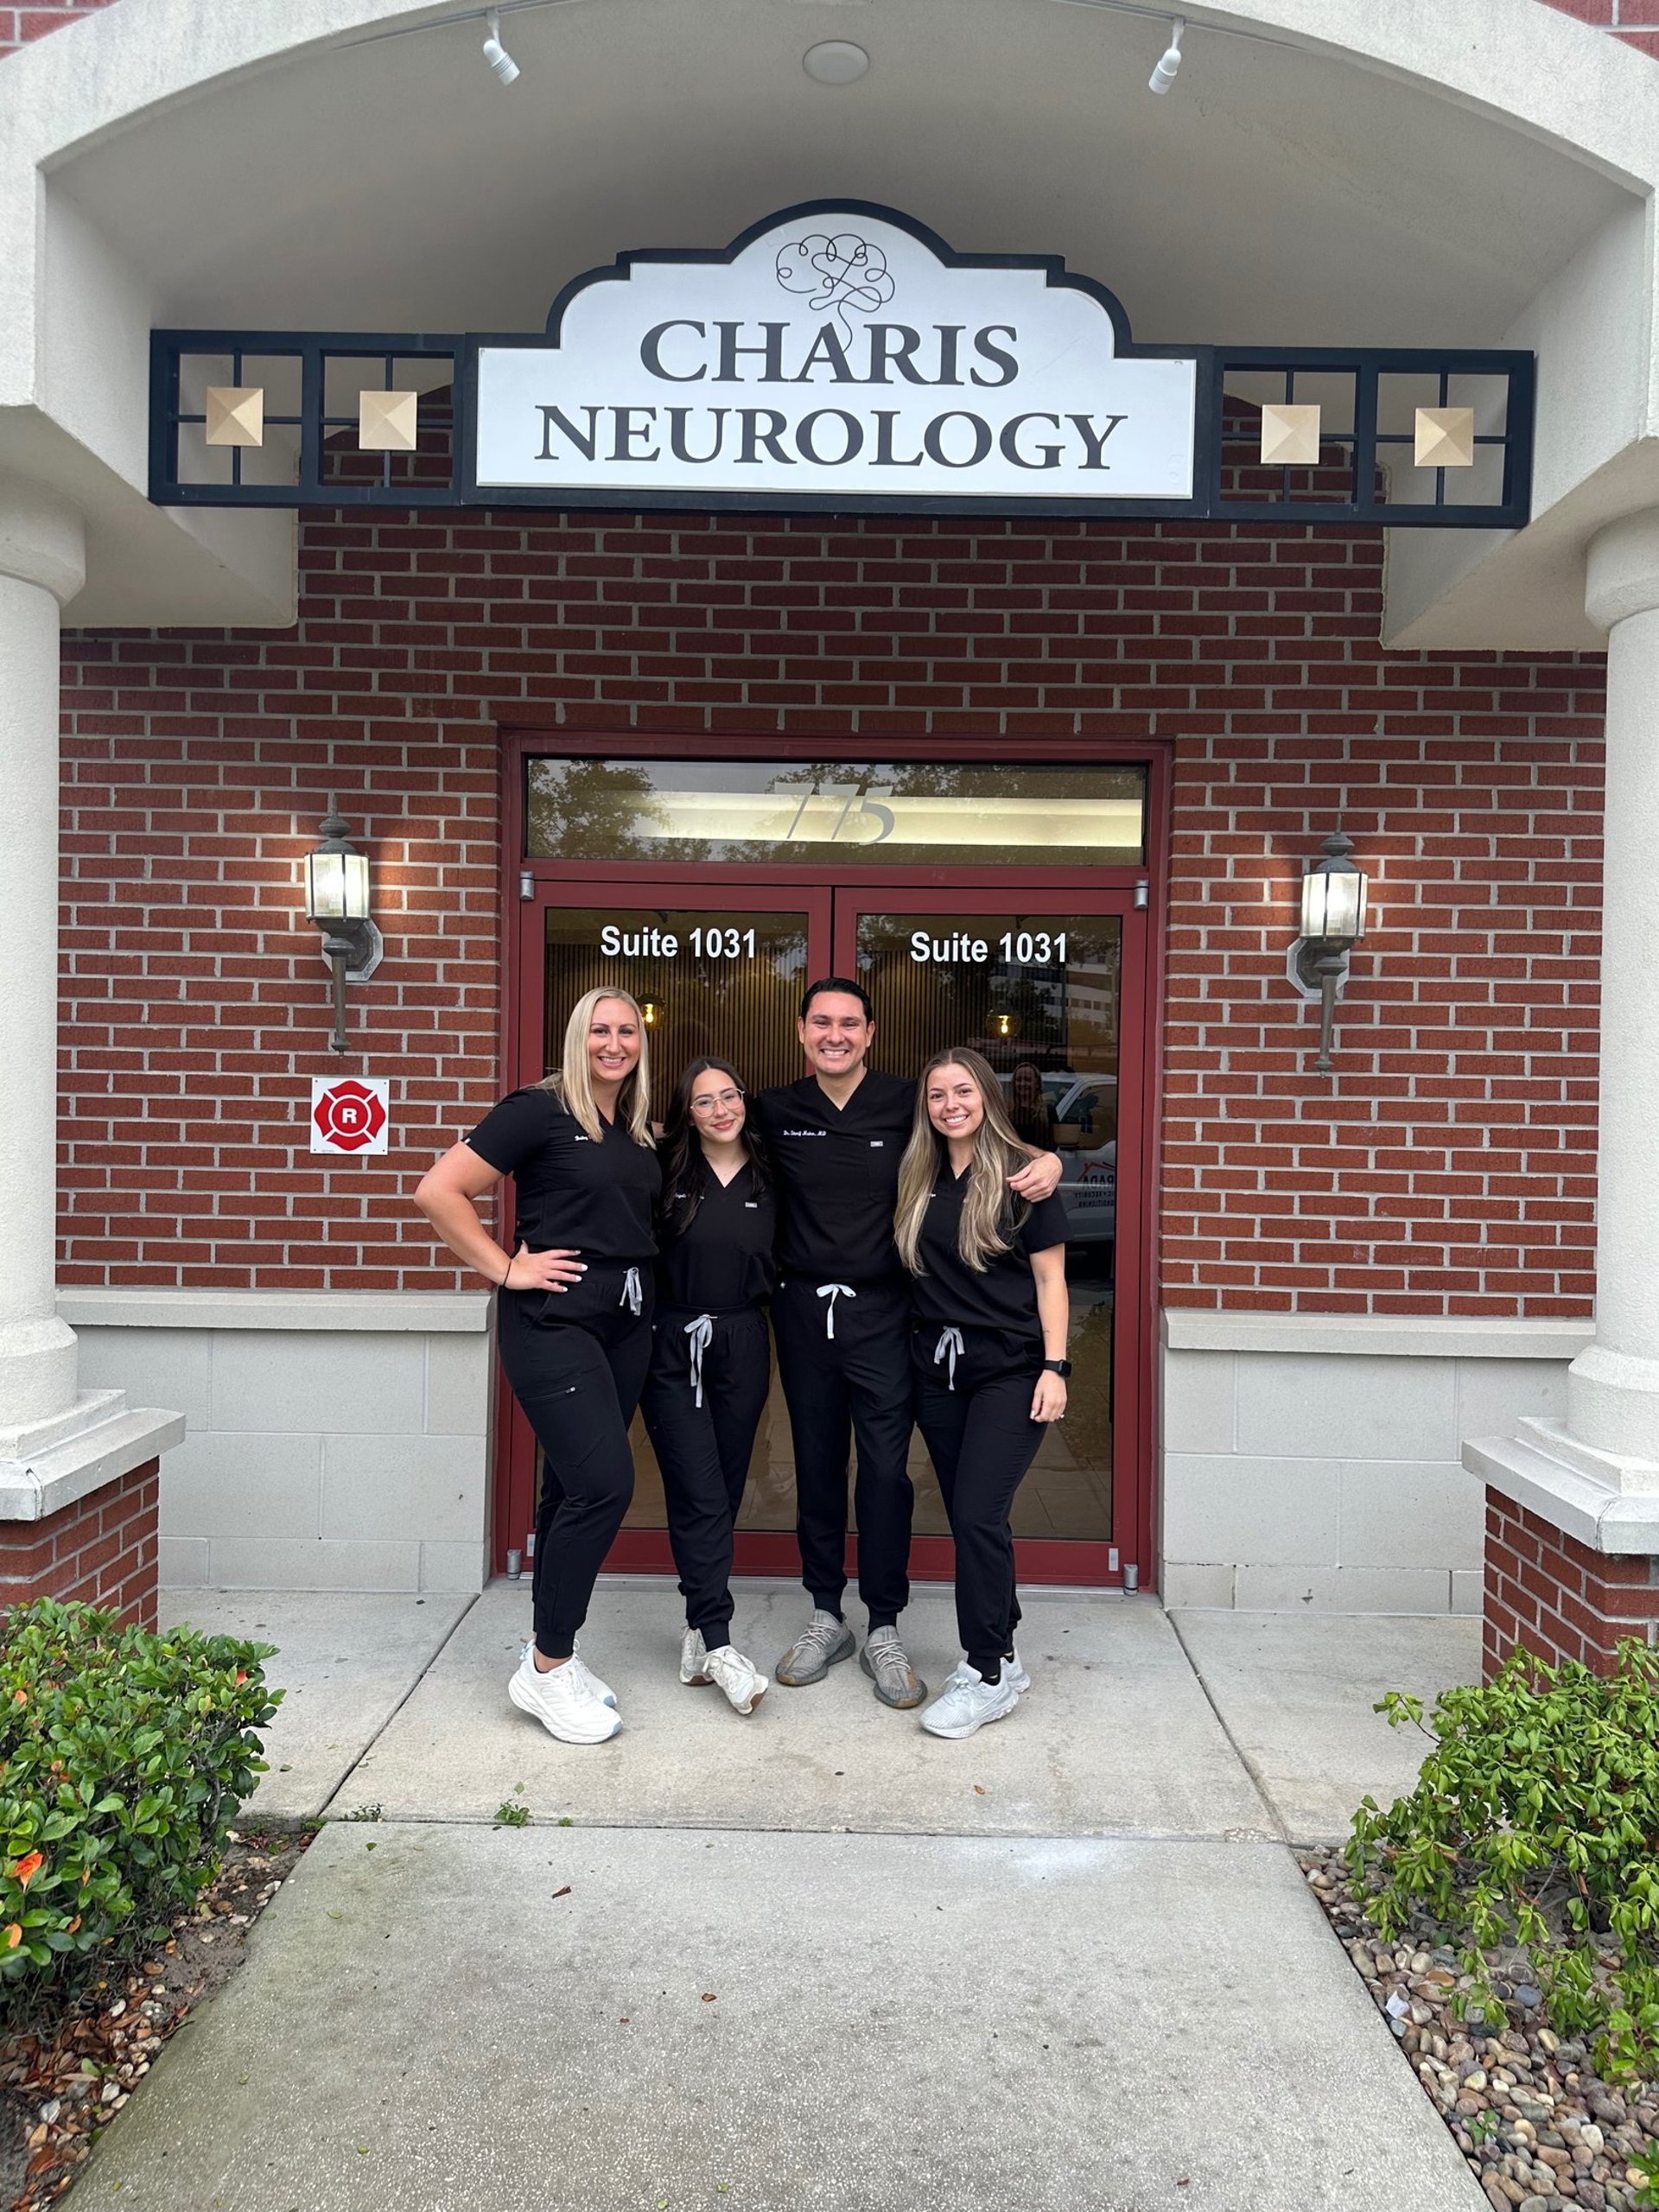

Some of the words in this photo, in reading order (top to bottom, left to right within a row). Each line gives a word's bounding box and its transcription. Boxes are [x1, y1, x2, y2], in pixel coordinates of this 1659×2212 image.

[640, 319, 1019, 387] CHARIS
[535, 405, 1128, 470] NEUROLOGY
[774, 781, 895, 846] 775
[601, 925, 678, 957] Suite
[690, 927, 755, 958] 1031
[910, 931, 988, 963] Suite
[999, 932, 1067, 963] 1031
[341, 1108, 358, 1124] R
